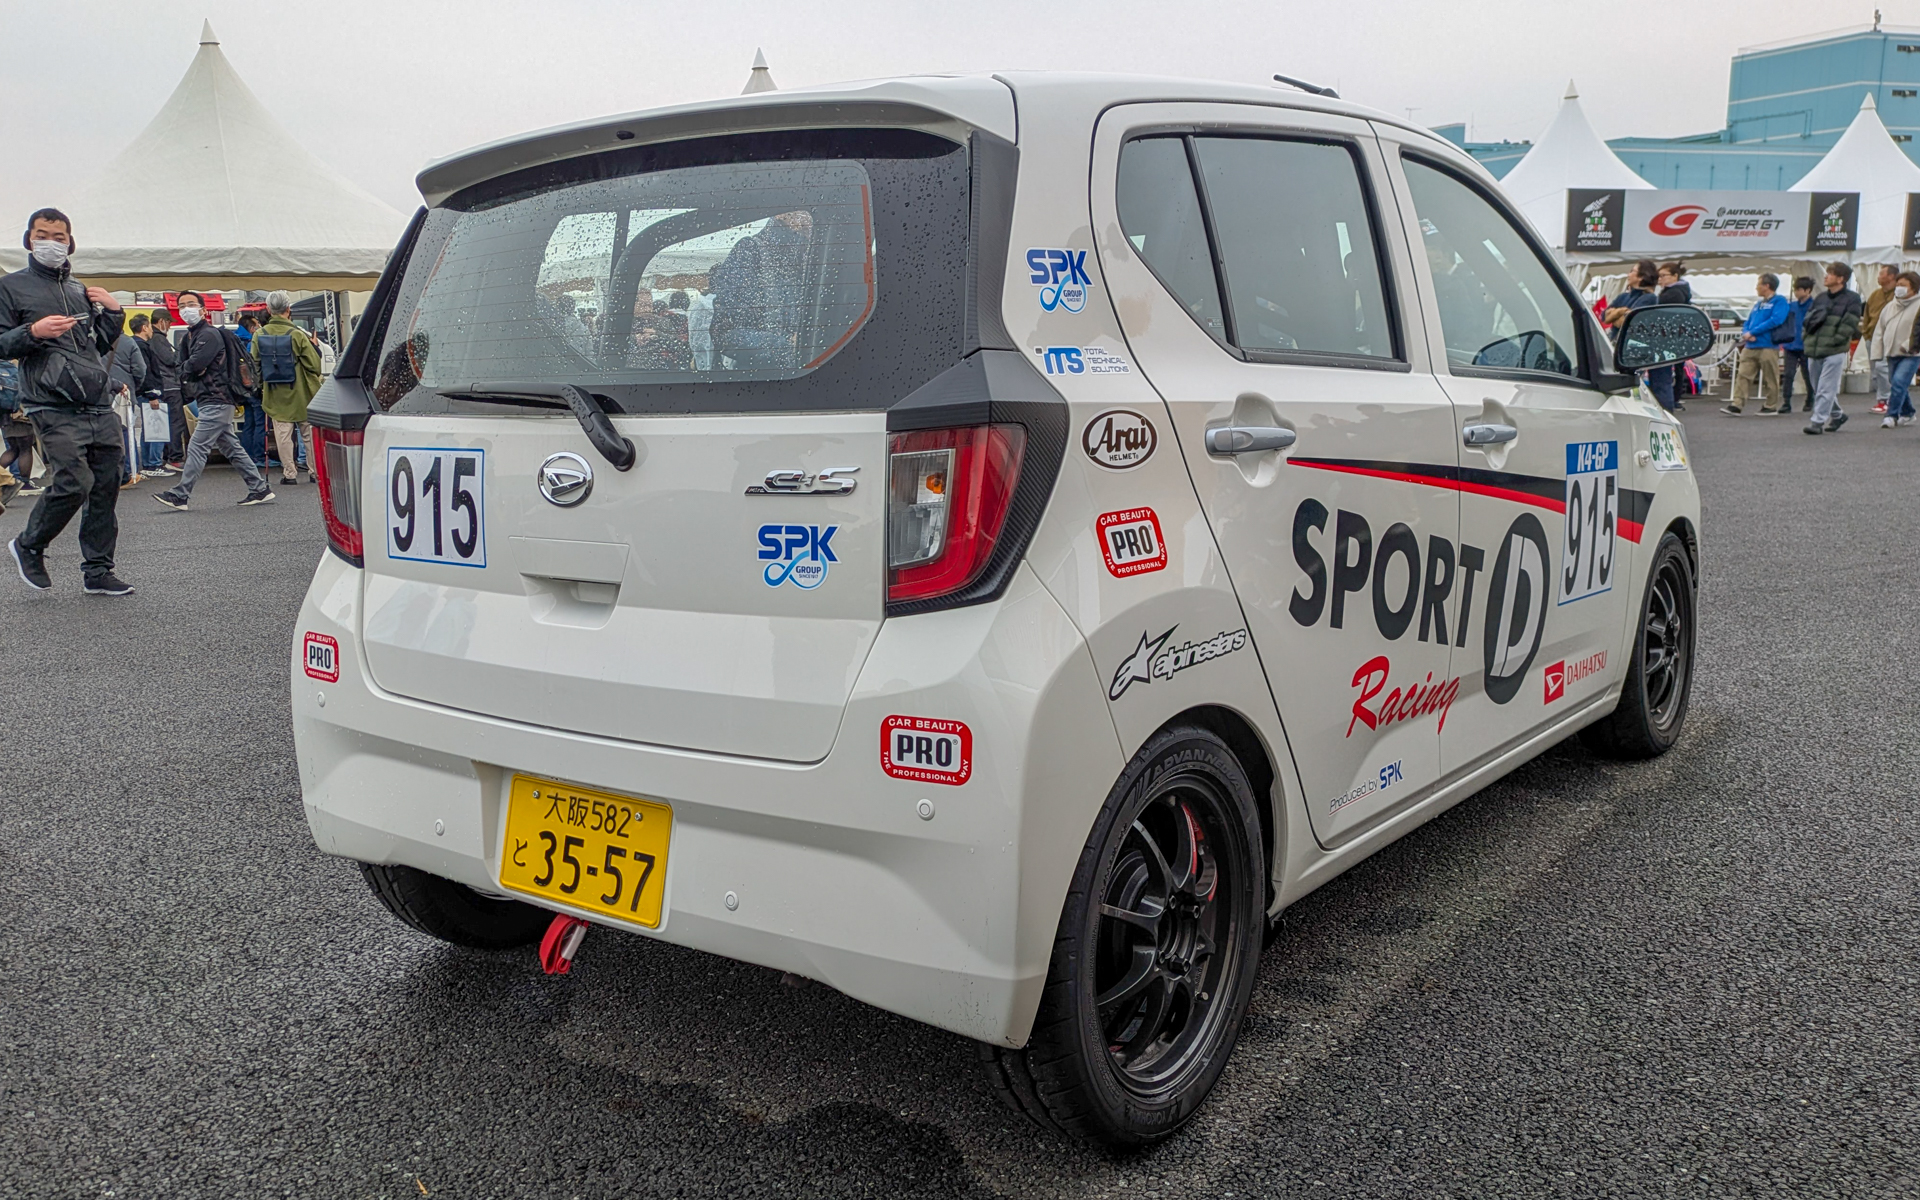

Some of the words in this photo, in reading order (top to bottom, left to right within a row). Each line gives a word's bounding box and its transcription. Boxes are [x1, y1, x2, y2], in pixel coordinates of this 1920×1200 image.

[1701, 219, 1759, 229] SUPER
[1760, 219, 1785, 229] GT
[1026, 249, 1092, 285] SPK
[1063, 289, 1082, 297] GROUP
[1089, 417, 1150, 457] Arai
[1576, 442, 1610, 472] K4-GP
[392, 455, 478, 558] 915
[1100, 514, 1118, 526] CAR
[1119, 509, 1151, 521] BEAUTY
[757, 525, 839, 562] SPK
[1110, 525, 1154, 560] PRO
[1564, 475, 1615, 596] 915
[795, 565, 821, 574] GROUP
[1105, 552, 1115, 571] THE
[1117, 561, 1162, 574] PROFESSIONAL
[1288, 497, 1485, 648] SPORT
[309, 644, 331, 670] PRO
[316, 635, 335, 645] BEAUTY
[1152, 628, 1247, 681] alpinestars
[1566, 649, 1608, 686] DAIHATSU
[1345, 655, 1461, 738] Racing
[888, 718, 912, 727] CAR
[915, 720, 963, 732] BEAUTY
[883, 751, 891, 770] THE
[892, 769, 957, 782] PROFESSIONAL
[959, 759, 969, 778] WAY
[897, 734, 953, 767] PRO
[1152, 749, 1204, 781] ADVAN
[1329, 781, 1367, 812] Produced
[1368, 777, 1378, 792] by
[1379, 759, 1404, 790] SPK
[513, 838, 528, 867] と
[533, 830, 656, 912] 35-57
